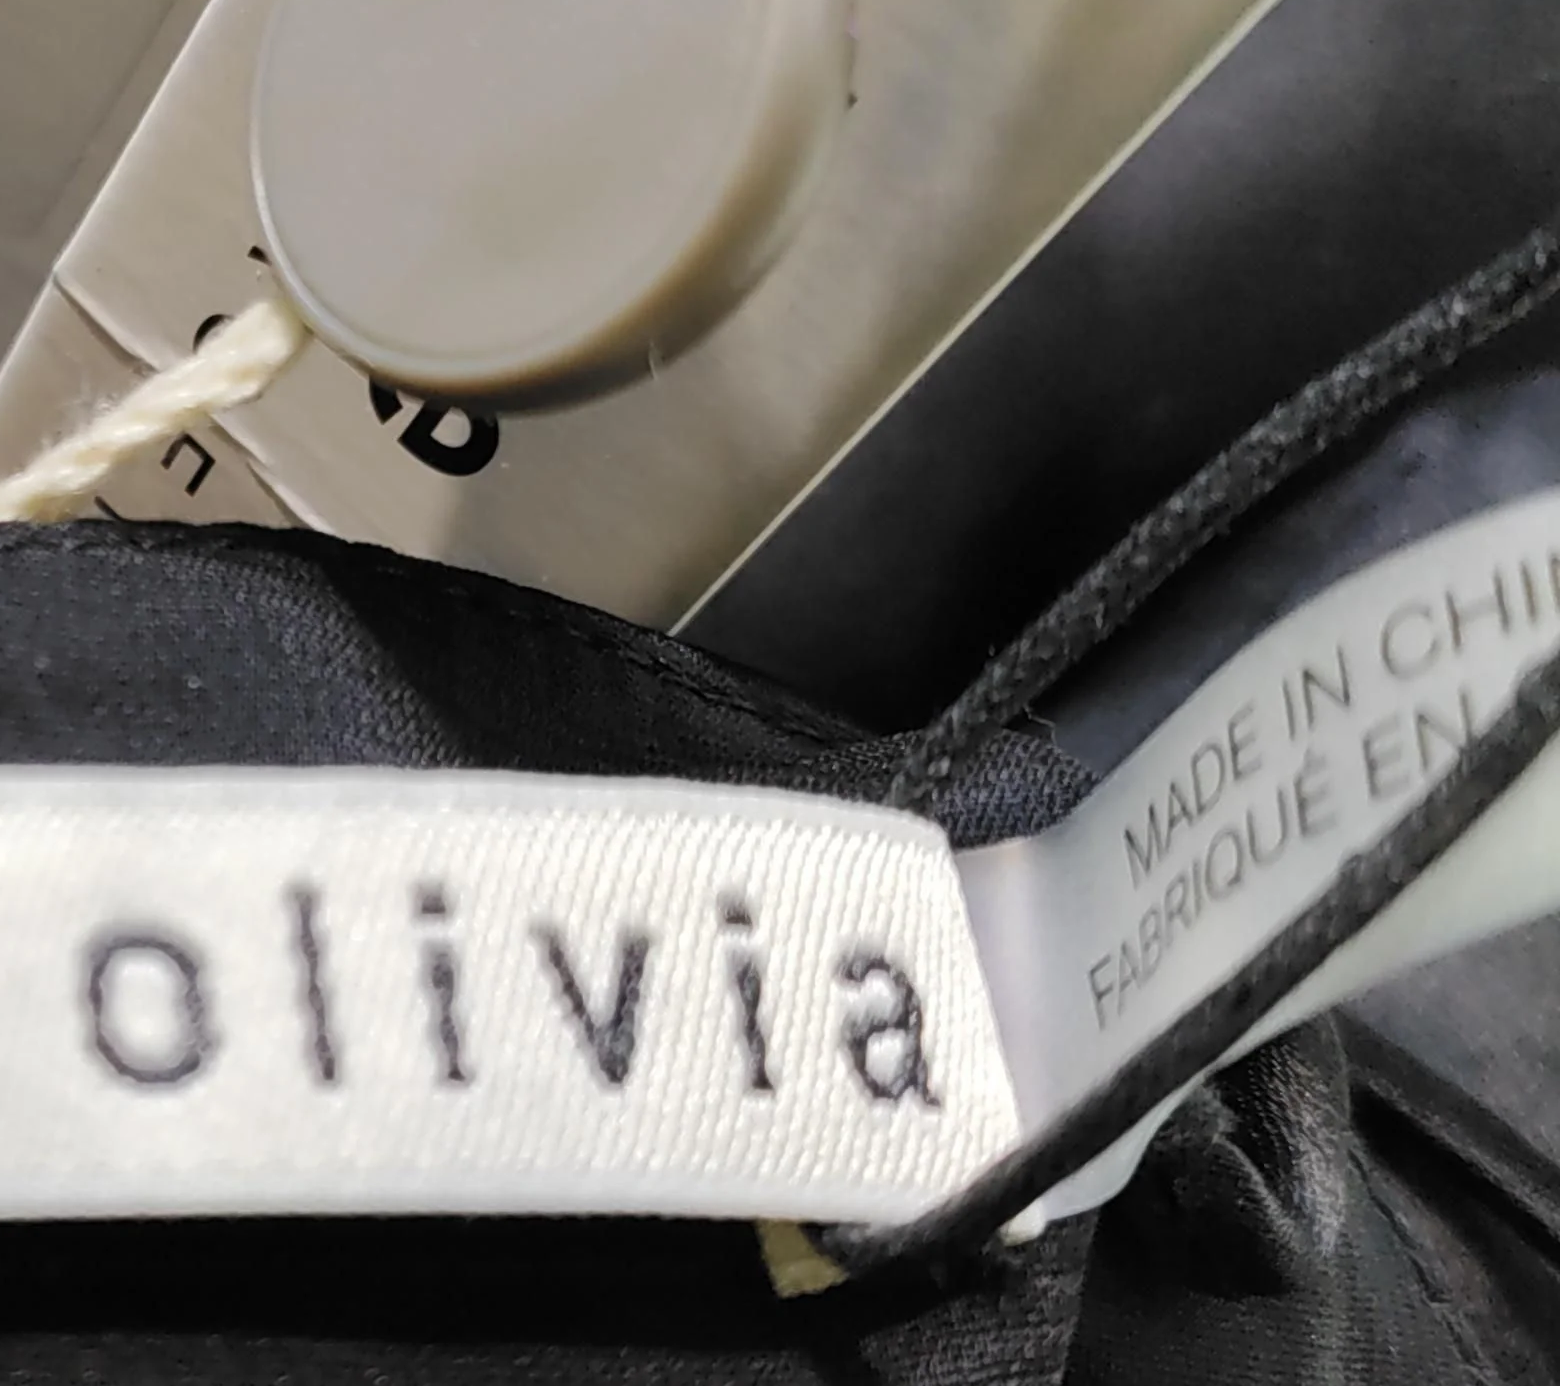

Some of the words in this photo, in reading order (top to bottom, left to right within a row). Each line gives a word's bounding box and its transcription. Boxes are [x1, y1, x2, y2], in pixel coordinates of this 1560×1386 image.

[1086, 741, 1338, 1031] FABRIQUÉ
[1361, 685, 1474, 793] EN
[1122, 703, 1264, 888] MADE
[1282, 645, 1353, 741] IN
[85, 879, 942, 1109] olivia
